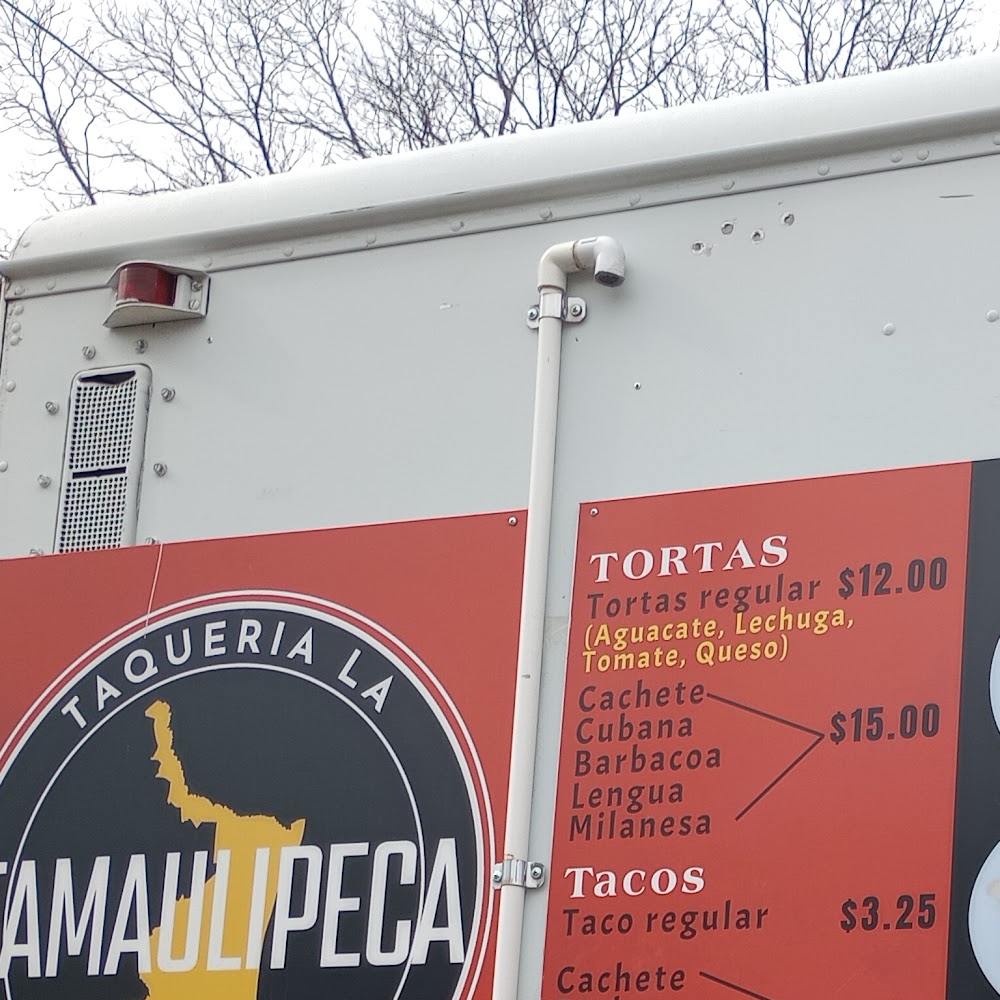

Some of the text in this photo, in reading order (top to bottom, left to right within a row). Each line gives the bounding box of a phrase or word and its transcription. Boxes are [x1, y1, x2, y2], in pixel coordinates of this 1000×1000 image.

[590, 534, 789, 584] TORTAS
[587, 556, 949, 620] Tortas regular $12.00
[584, 605, 855, 652] (Aguacate, Lechuga,
[61, 618, 395, 730] TAQUERIA LA
[582, 634, 789, 673] Tomate, Queso)
[578, 679, 706, 713] Cachete
[576, 702, 941, 745] Cubana $15.00
[574, 743, 722, 777] Barbacoa
[571, 781, 684, 813] Lengua
[569, 809, 712, 842] Milanesa
[564, 866, 706, 899] Tacos
[0, 838, 465, 979] AMAULIPECA
[562, 893, 937, 940] Taco regular $3.25
[556, 962, 686, 994] Cachete
